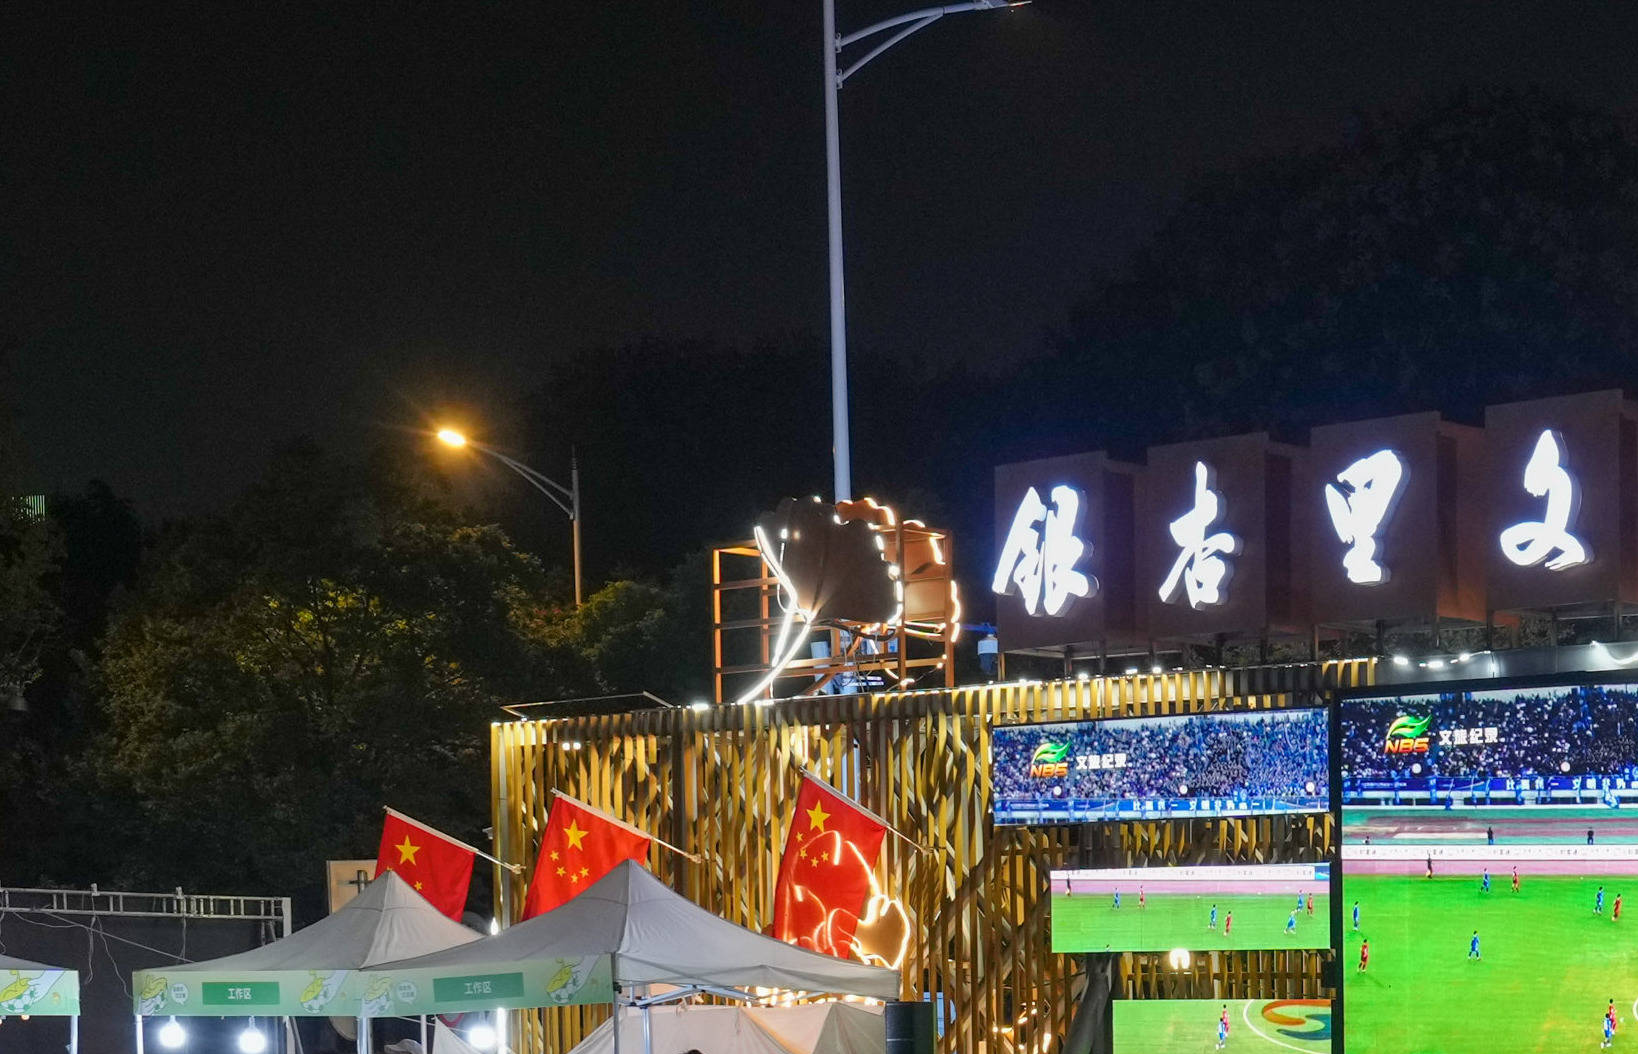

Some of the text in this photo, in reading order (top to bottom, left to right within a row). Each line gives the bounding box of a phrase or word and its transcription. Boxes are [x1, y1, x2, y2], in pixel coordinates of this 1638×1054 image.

[228, 988, 251, 1000] 工作区
[464, 981, 492, 995] 工作区
